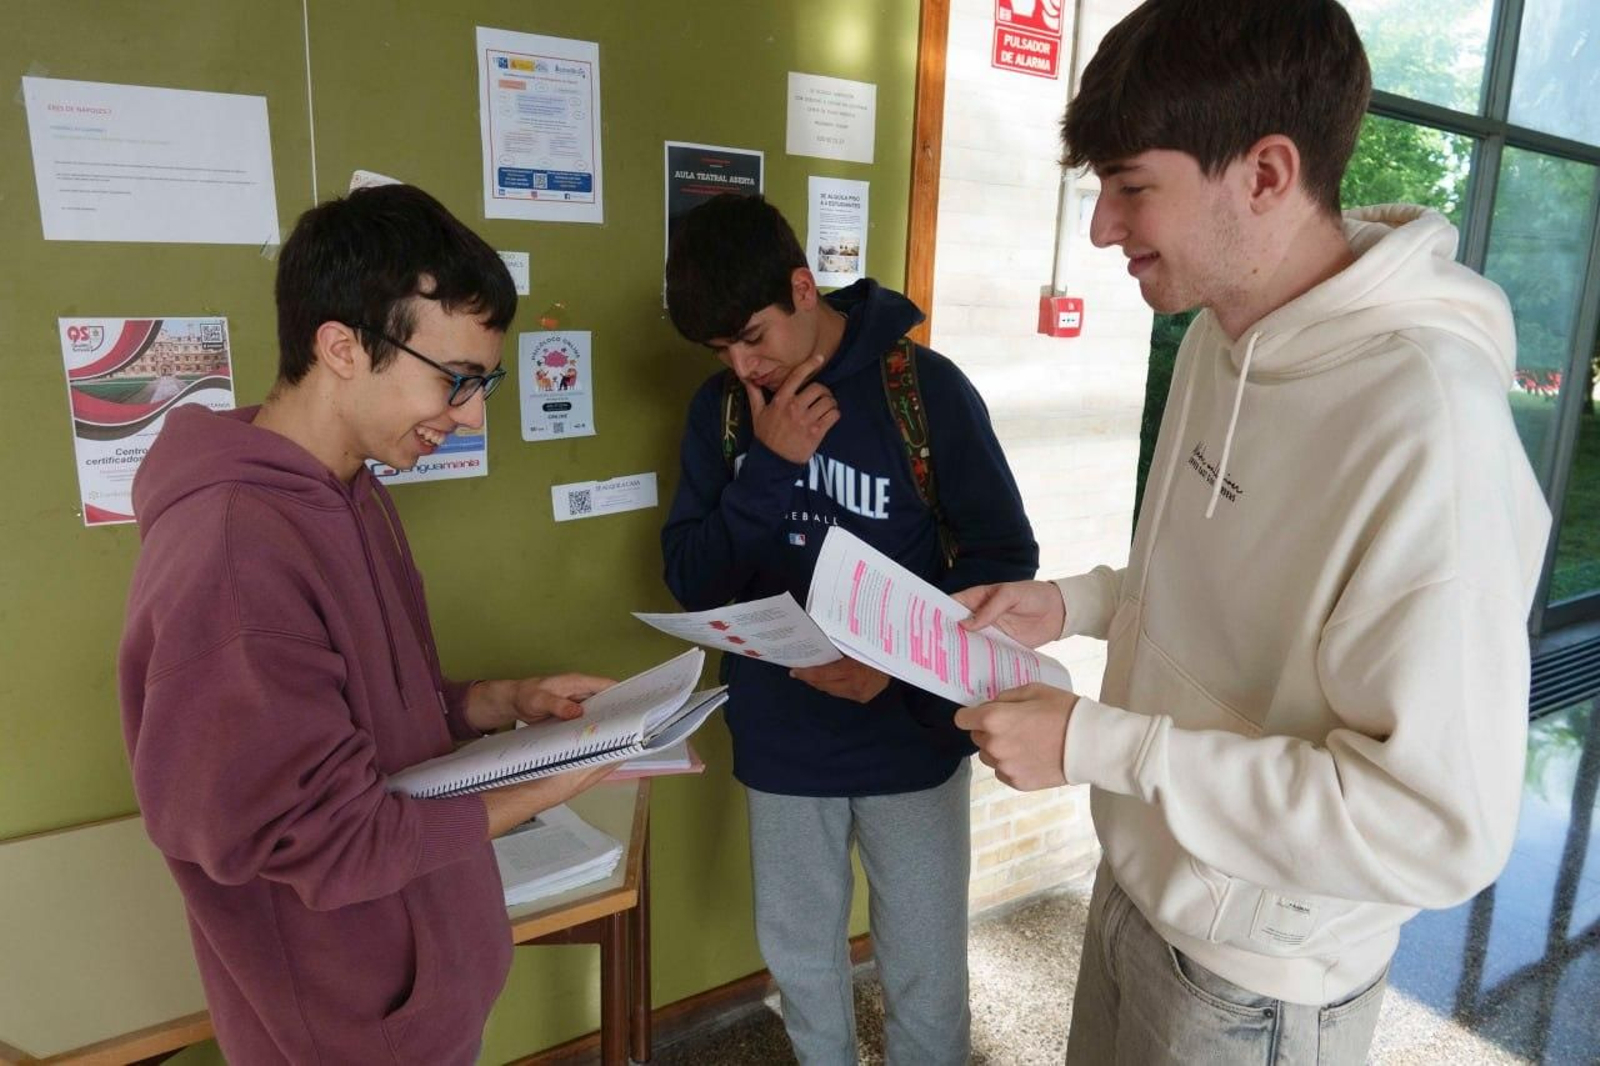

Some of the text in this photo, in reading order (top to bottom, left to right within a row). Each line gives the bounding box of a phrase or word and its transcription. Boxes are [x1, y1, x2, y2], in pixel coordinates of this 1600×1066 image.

[1003, 34, 1051, 55] PULSADOR
[1000, 50, 1051, 71] DE ALARMA
[674, 170, 695, 180] AULA
[696, 173, 727, 183] TEATRAL
[400, 458, 480, 474] nguamania
[809, 454, 890, 519] VILLE
[784, 511, 838, 526] EBALL
